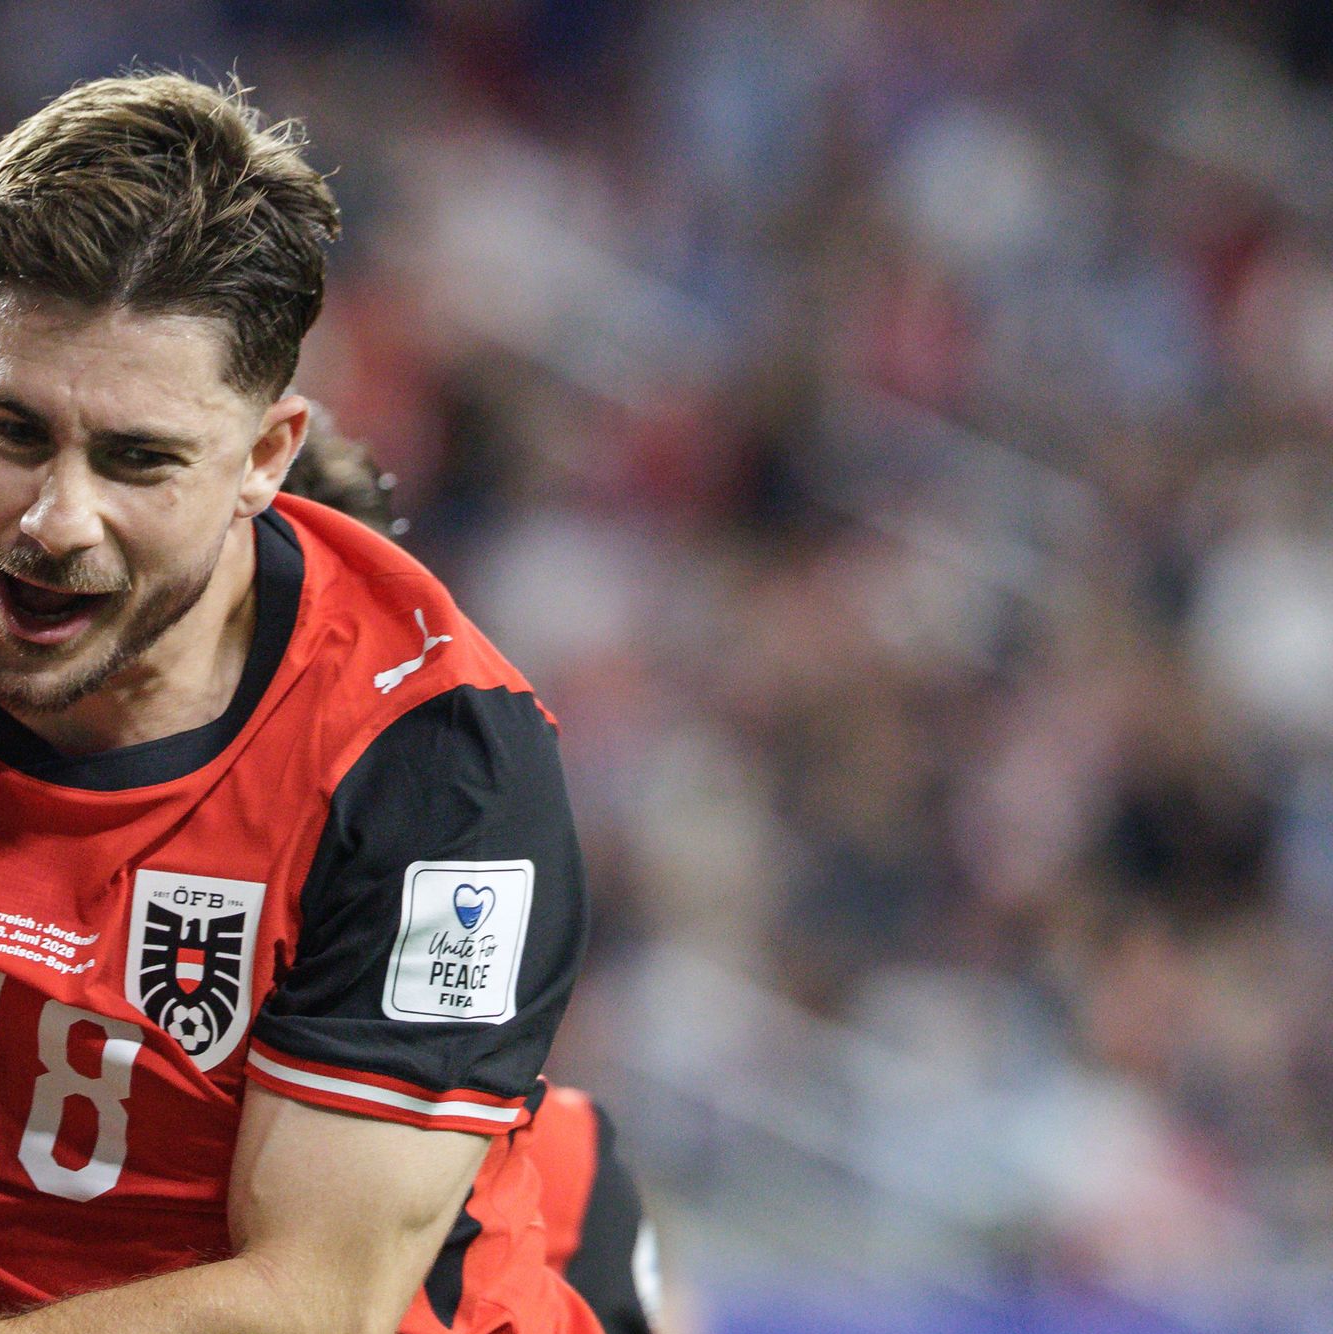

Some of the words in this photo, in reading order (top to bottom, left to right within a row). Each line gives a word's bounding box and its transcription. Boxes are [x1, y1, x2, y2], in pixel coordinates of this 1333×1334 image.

[173, 885, 224, 909] ÖFB
[9, 929, 41, 946] Juni
[40, 937, 76, 959] 2026
[428, 931, 476, 960] Unite
[478, 934, 499, 961] For
[429, 961, 490, 990] PEACE
[439, 993, 473, 1008] FIFA
